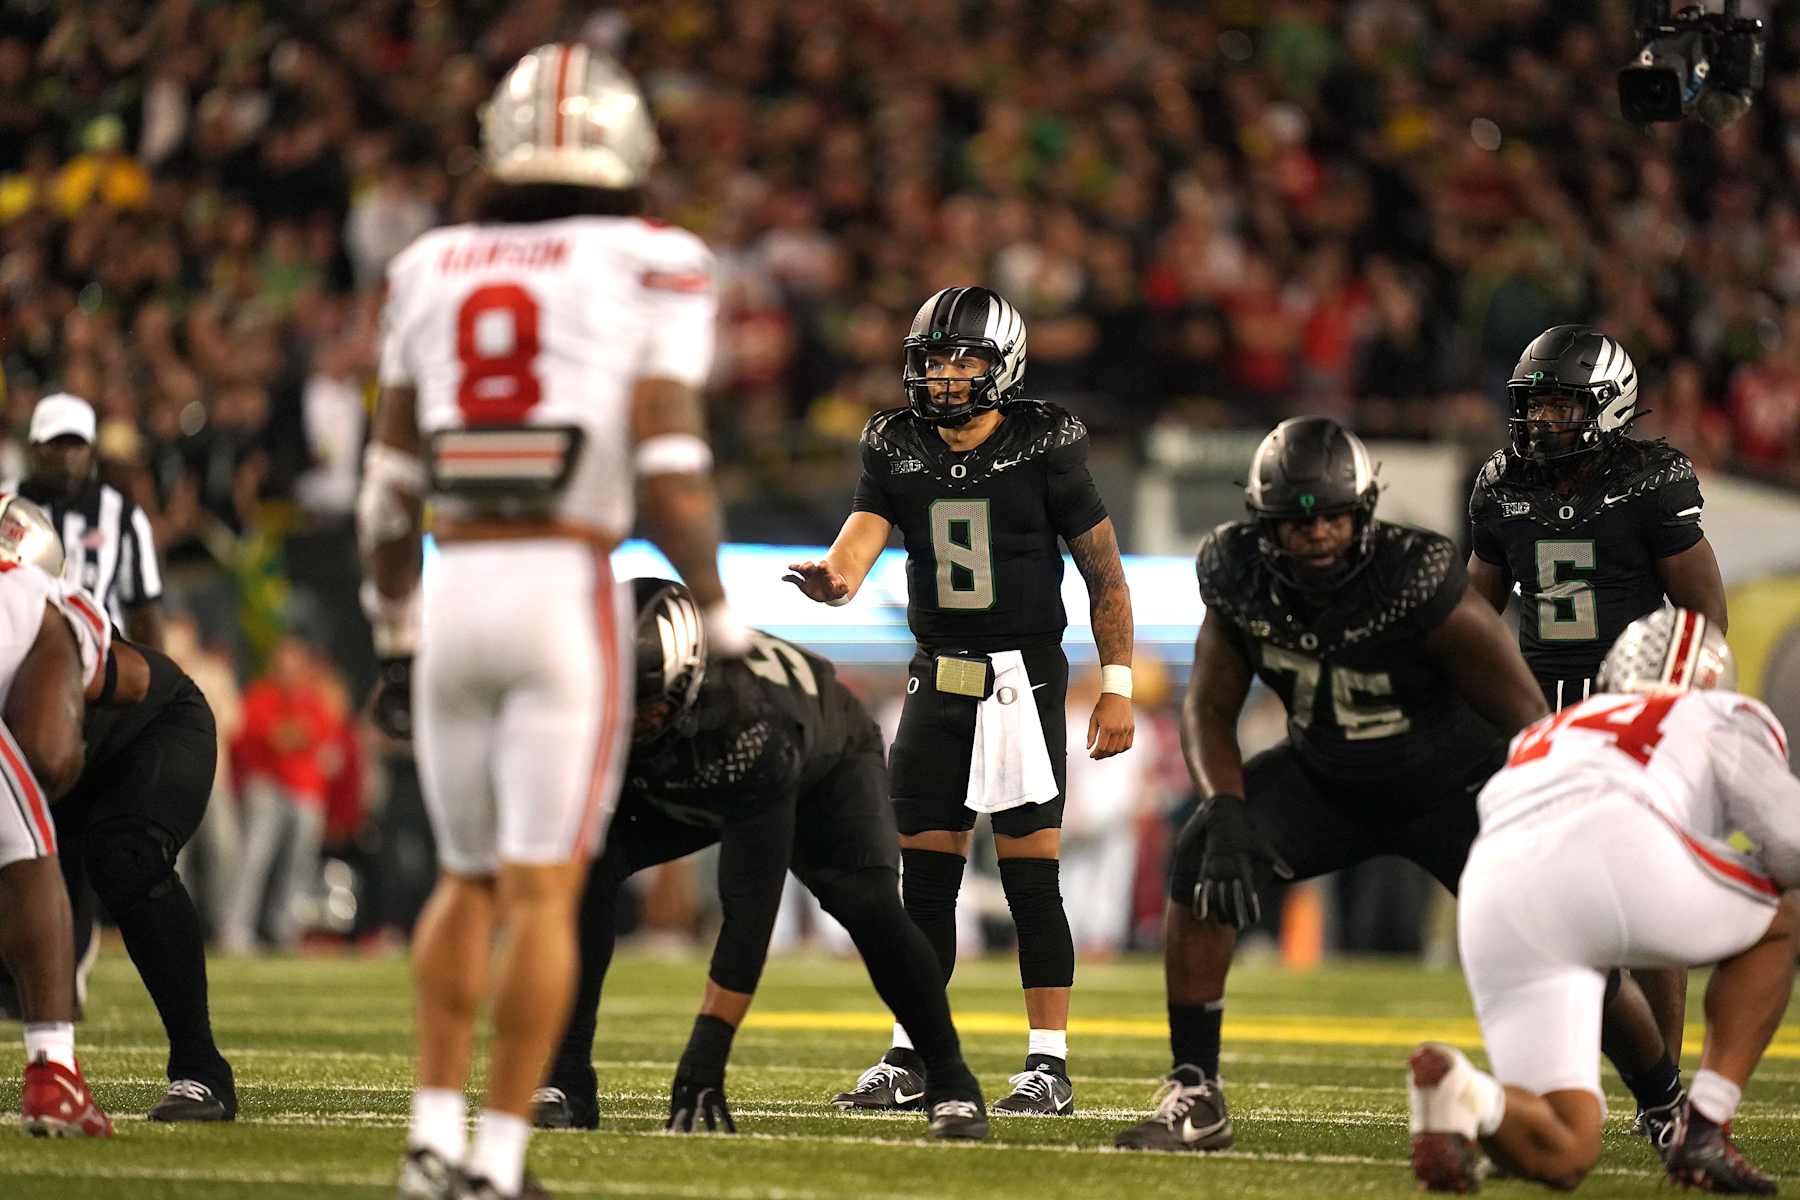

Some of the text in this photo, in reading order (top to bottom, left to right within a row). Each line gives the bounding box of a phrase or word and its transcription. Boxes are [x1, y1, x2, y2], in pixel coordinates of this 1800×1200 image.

[456, 281, 541, 427] 8
[951, 464, 967, 478] O
[1559, 505, 1575, 520] O
[928, 498, 996, 611] 8
[1535, 539, 1599, 640] 6
[996, 686, 1018, 705] O
